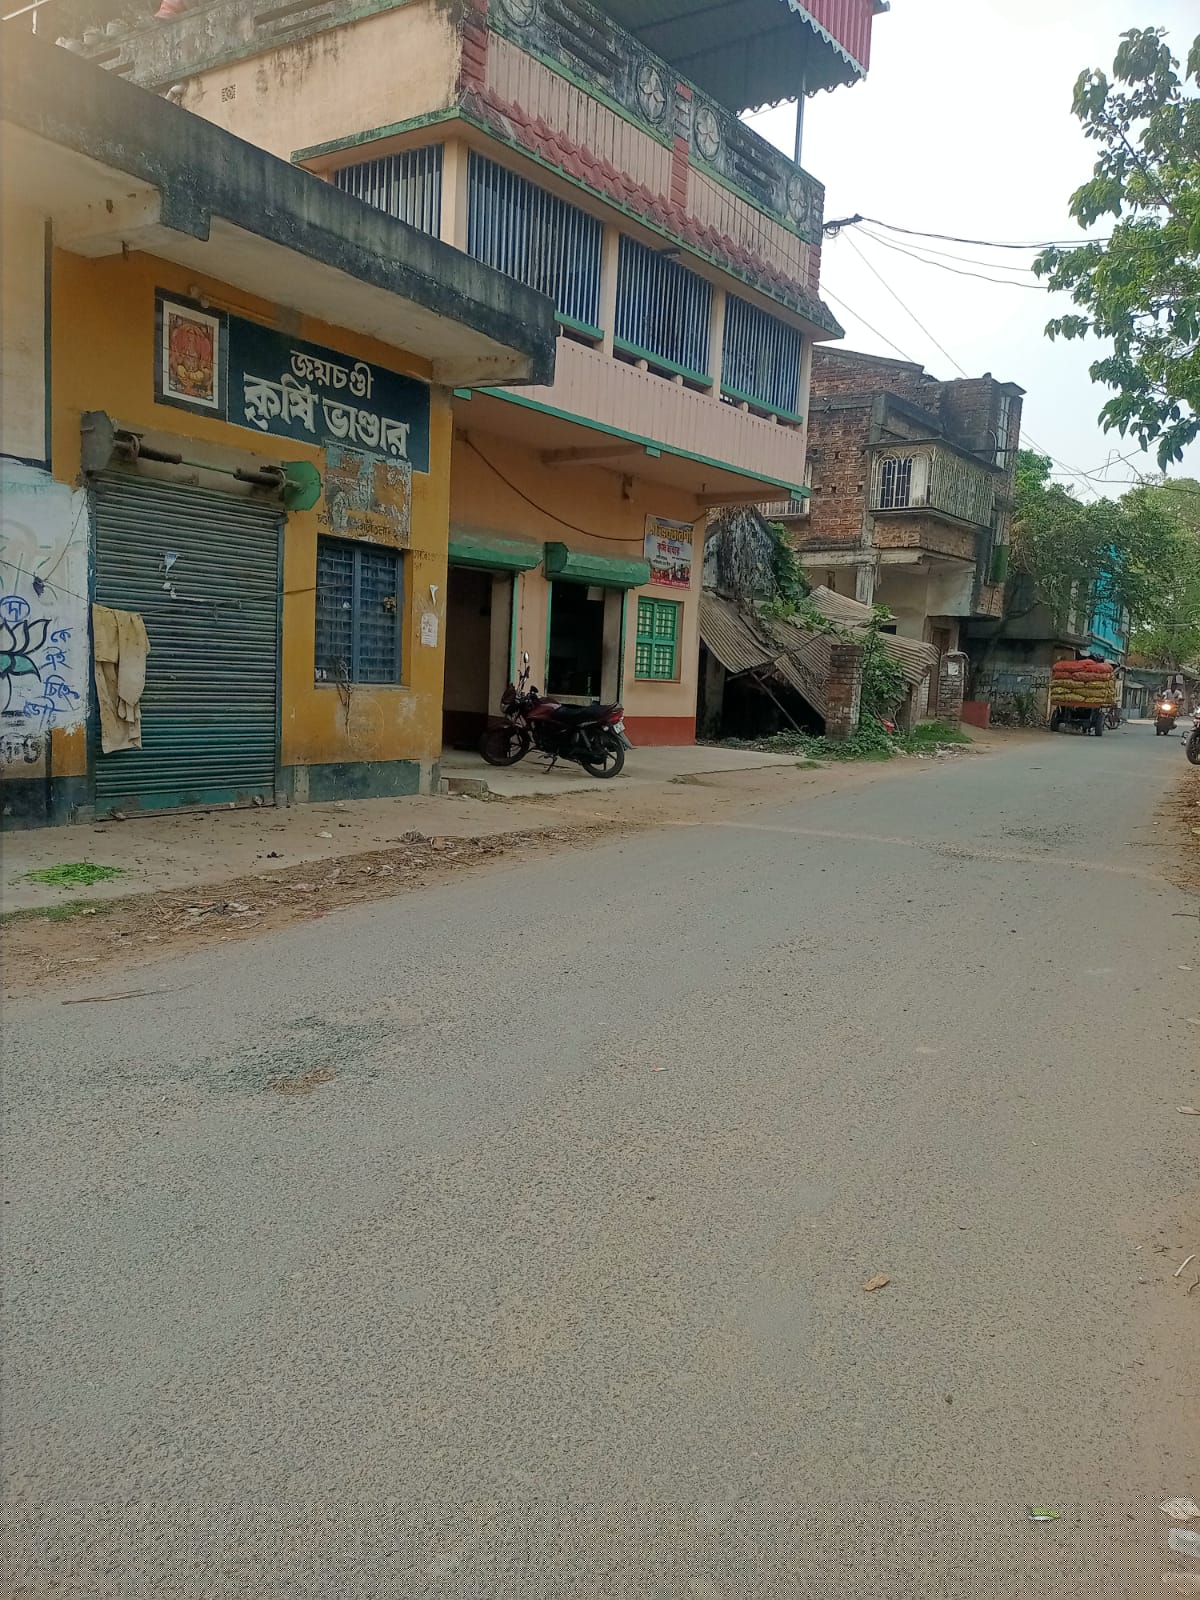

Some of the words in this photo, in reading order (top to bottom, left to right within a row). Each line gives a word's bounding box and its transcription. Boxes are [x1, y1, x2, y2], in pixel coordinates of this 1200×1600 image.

[290, 350, 375, 399] জয়চণ্ডী
[243, 371, 319, 431] কৃষি
[322, 398, 410, 458] ভাণ্ডার
